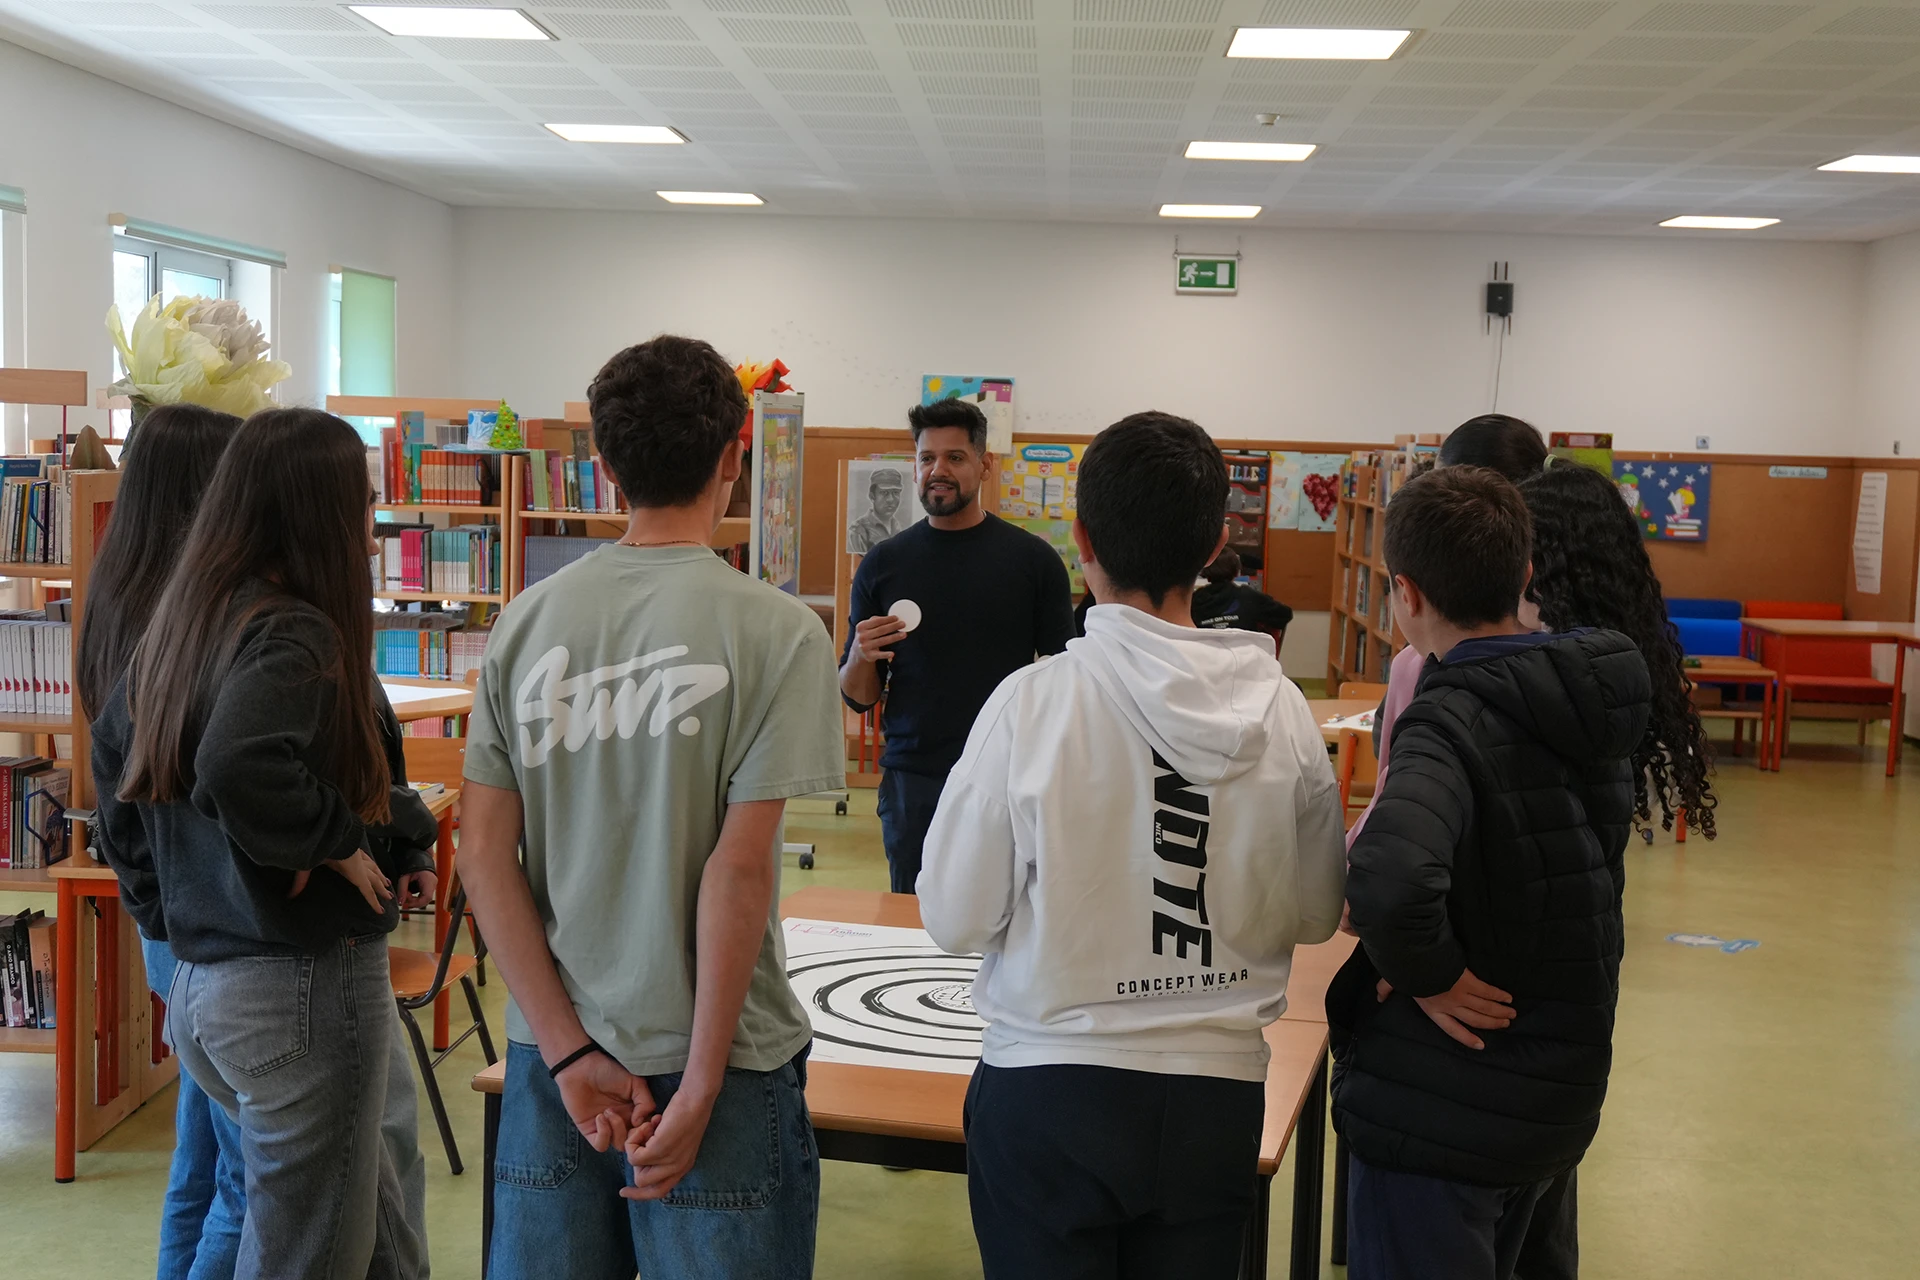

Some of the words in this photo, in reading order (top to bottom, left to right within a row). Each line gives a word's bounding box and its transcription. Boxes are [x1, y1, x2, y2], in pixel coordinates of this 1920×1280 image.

[1154, 821, 1163, 845] NICO
[1117, 975, 1195, 995] CONCEPT
[1201, 968, 1249, 987] WEAR
